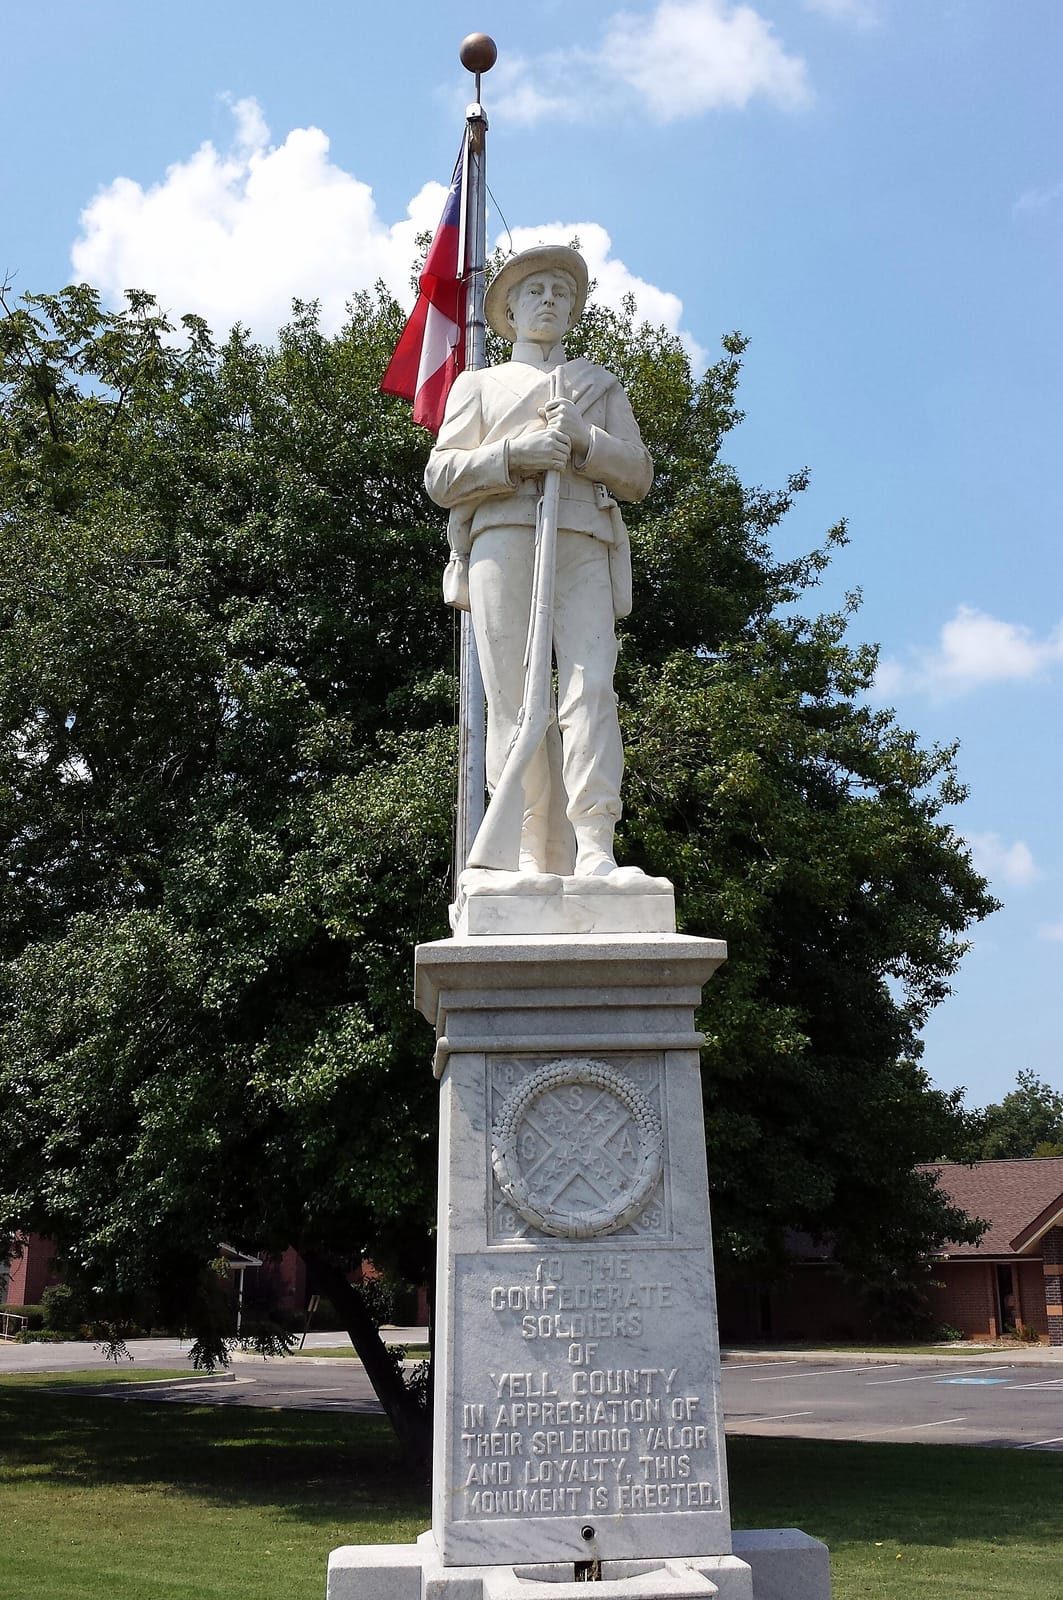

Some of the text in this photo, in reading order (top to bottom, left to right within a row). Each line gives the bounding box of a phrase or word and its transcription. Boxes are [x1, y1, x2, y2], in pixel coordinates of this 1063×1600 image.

[569, 1086, 583, 1110] S
[522, 1132, 536, 1160] C
[617, 1129, 637, 1160] A
[642, 1210, 660, 1227] 65
[536, 1256, 631, 1281] TO THE
[491, 1283, 673, 1311] CONFEDERATE
[522, 1311, 642, 1339] SOLDIERS
[568, 1343, 598, 1366] OF
[490, 1368, 678, 1397] YELL COUNTY
[463, 1397, 699, 1428] IN APPRECIATION OF
[461, 1426, 708, 1457] THEIR SPLENDID VALOR
[465, 1455, 691, 1487] AND LOYALTY, THIS
[464, 1487, 582, 1514] MONUMENT
[589, 1487, 609, 1510] IS
